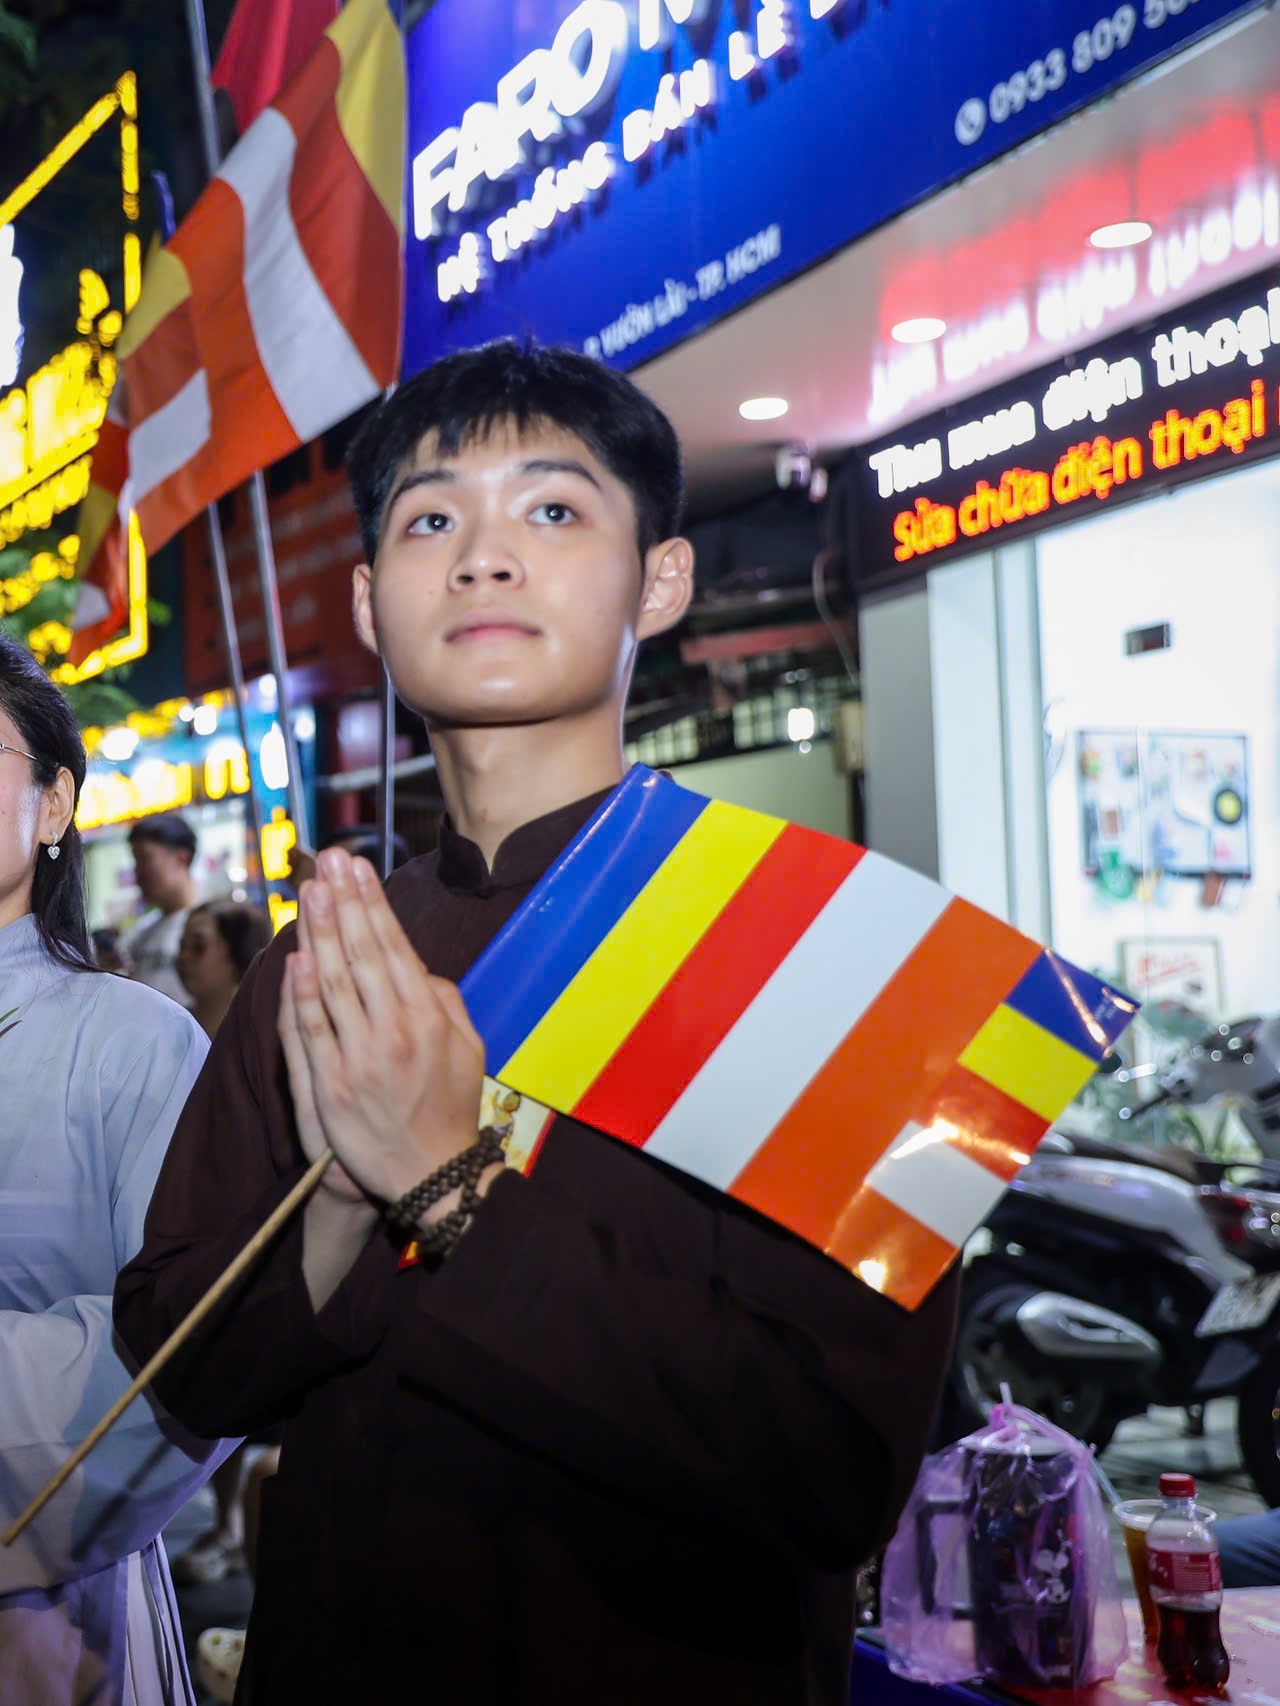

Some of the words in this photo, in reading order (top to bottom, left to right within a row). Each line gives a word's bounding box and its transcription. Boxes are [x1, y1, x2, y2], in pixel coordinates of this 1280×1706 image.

[413, 0, 628, 240] FARO
[989, 48, 1068, 124] 0933
[1072, 4, 1137, 73] 809
[869, 438, 943, 499] Thu
[947, 401, 1037, 471] mua
[1052, 435, 1144, 504] điện
[1148, 378, 1266, 470] thoại
